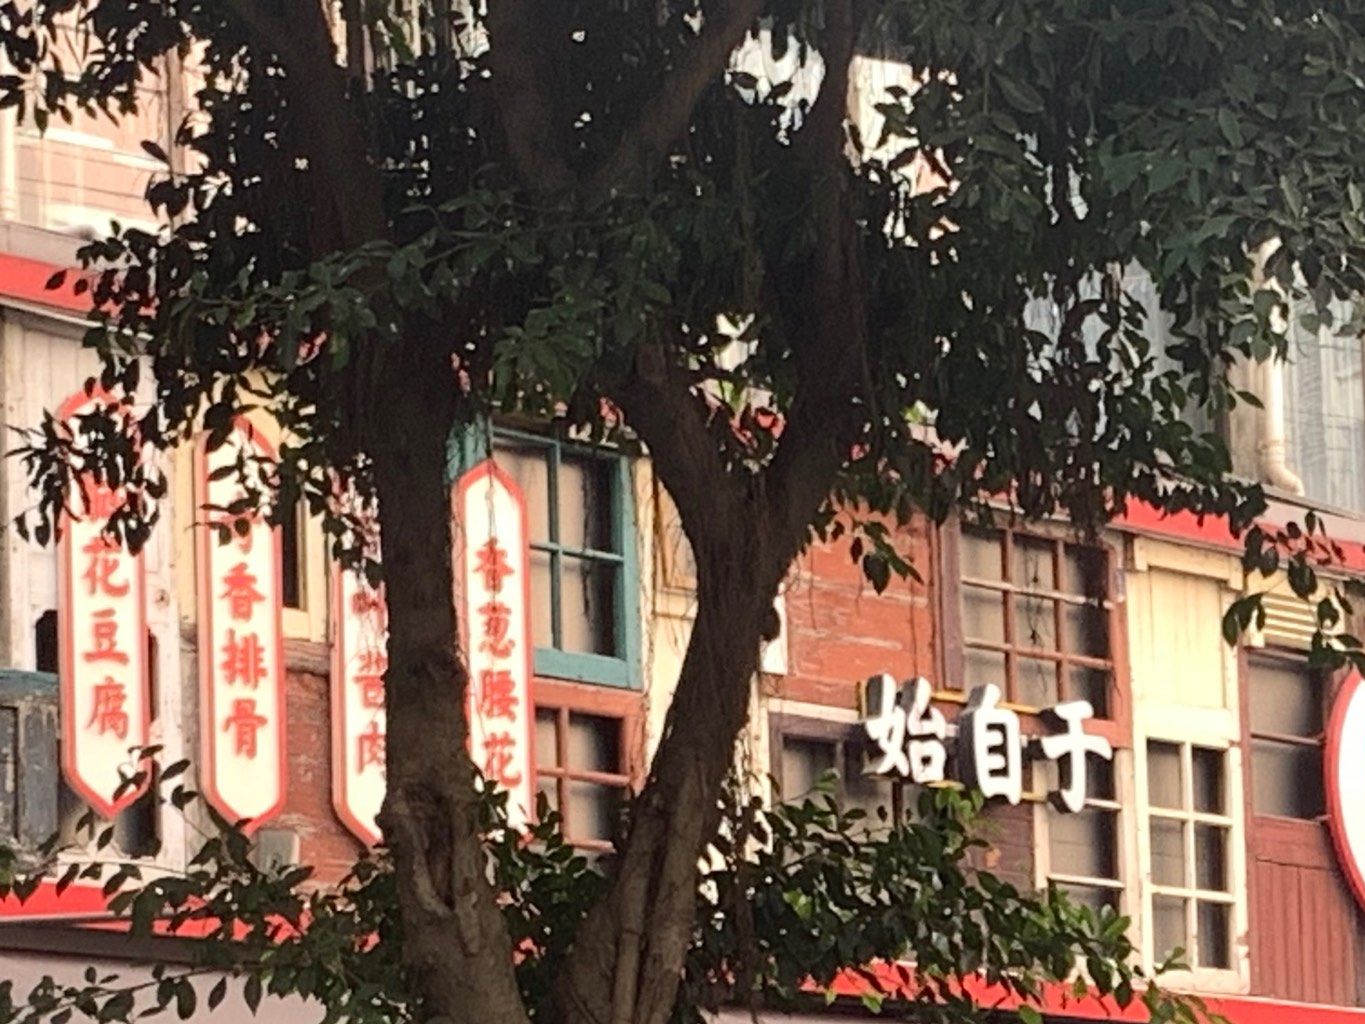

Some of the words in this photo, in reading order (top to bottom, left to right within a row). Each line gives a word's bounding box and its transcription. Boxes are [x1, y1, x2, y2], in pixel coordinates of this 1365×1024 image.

[75, 474, 132, 742] 花豆腐
[350, 512, 388, 775] 叶酱肉
[472, 535, 523, 788] 香葱腰花
[862, 672, 1113, 814] 始自于
